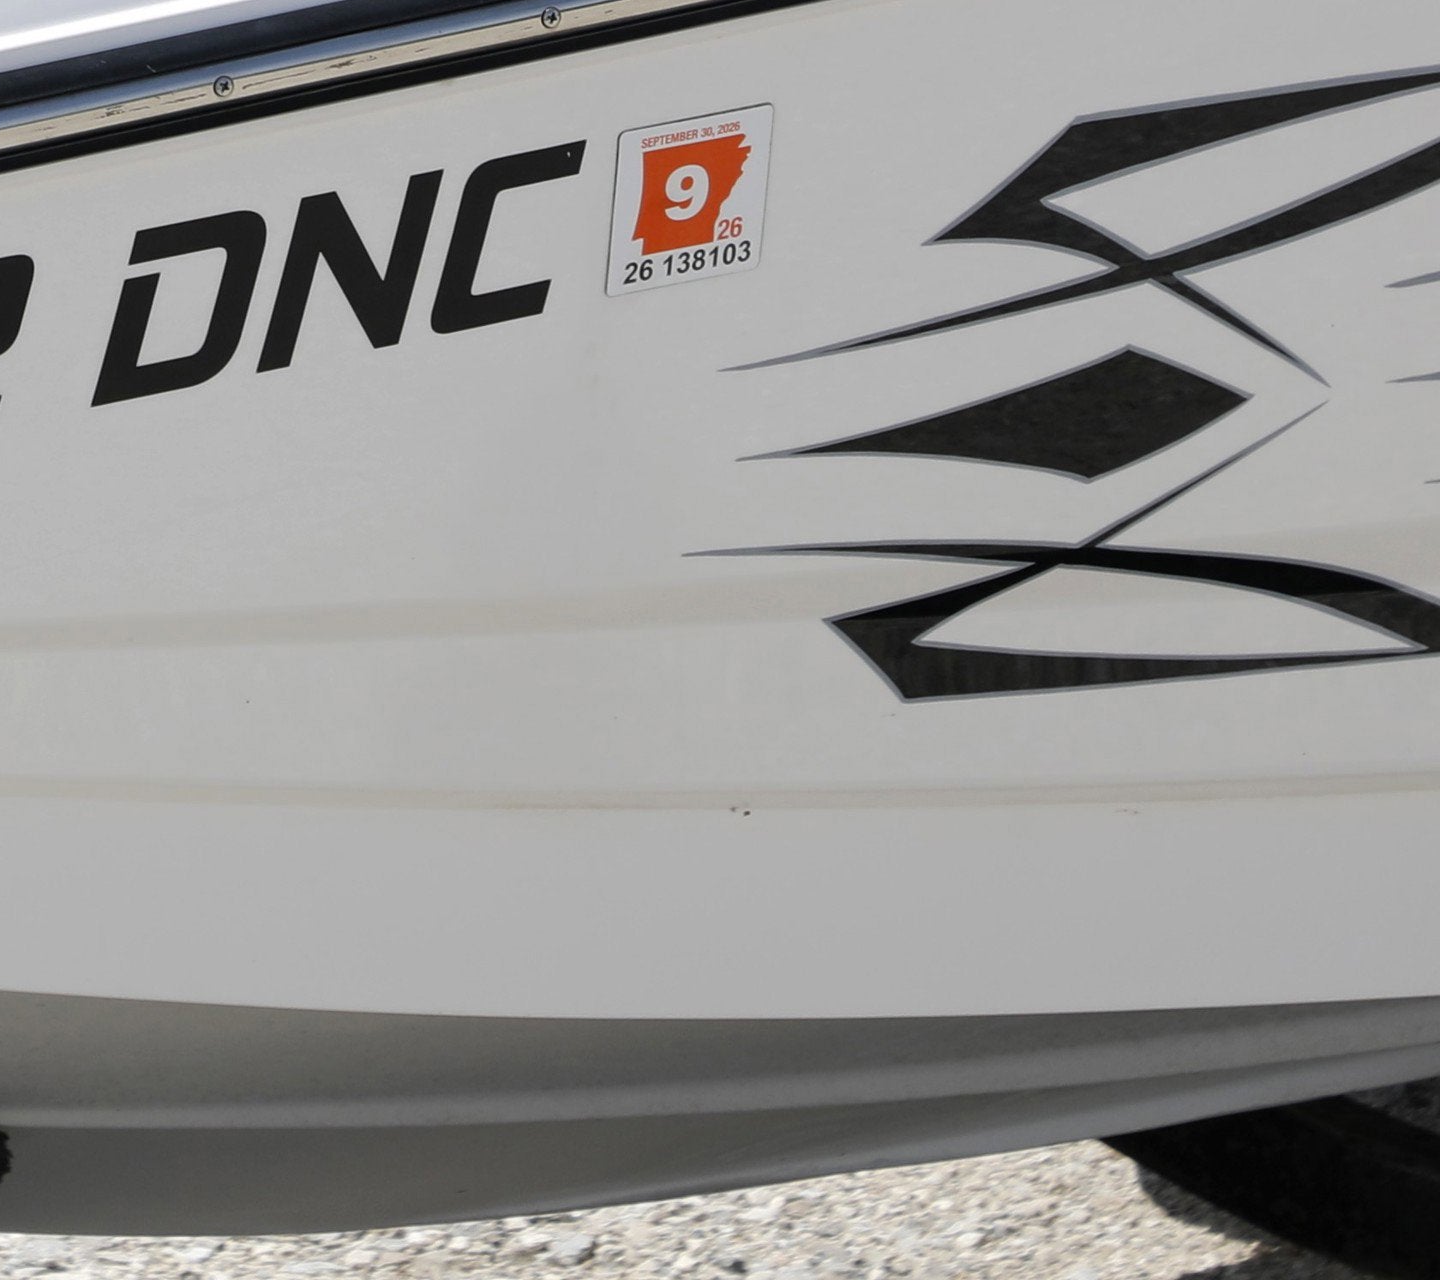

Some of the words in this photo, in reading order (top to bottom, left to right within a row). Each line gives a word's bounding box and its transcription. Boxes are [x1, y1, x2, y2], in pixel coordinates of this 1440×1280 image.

[641, 128, 699, 149] SEPTEMBER
[700, 126, 716, 140] 30,
[717, 121, 741, 135] 2026
[664, 164, 710, 221] 9
[717, 216, 743, 241] 26
[91, 140, 586, 407] DNC
[623, 259, 653, 285] 26
[662, 240, 751, 276] 138103
